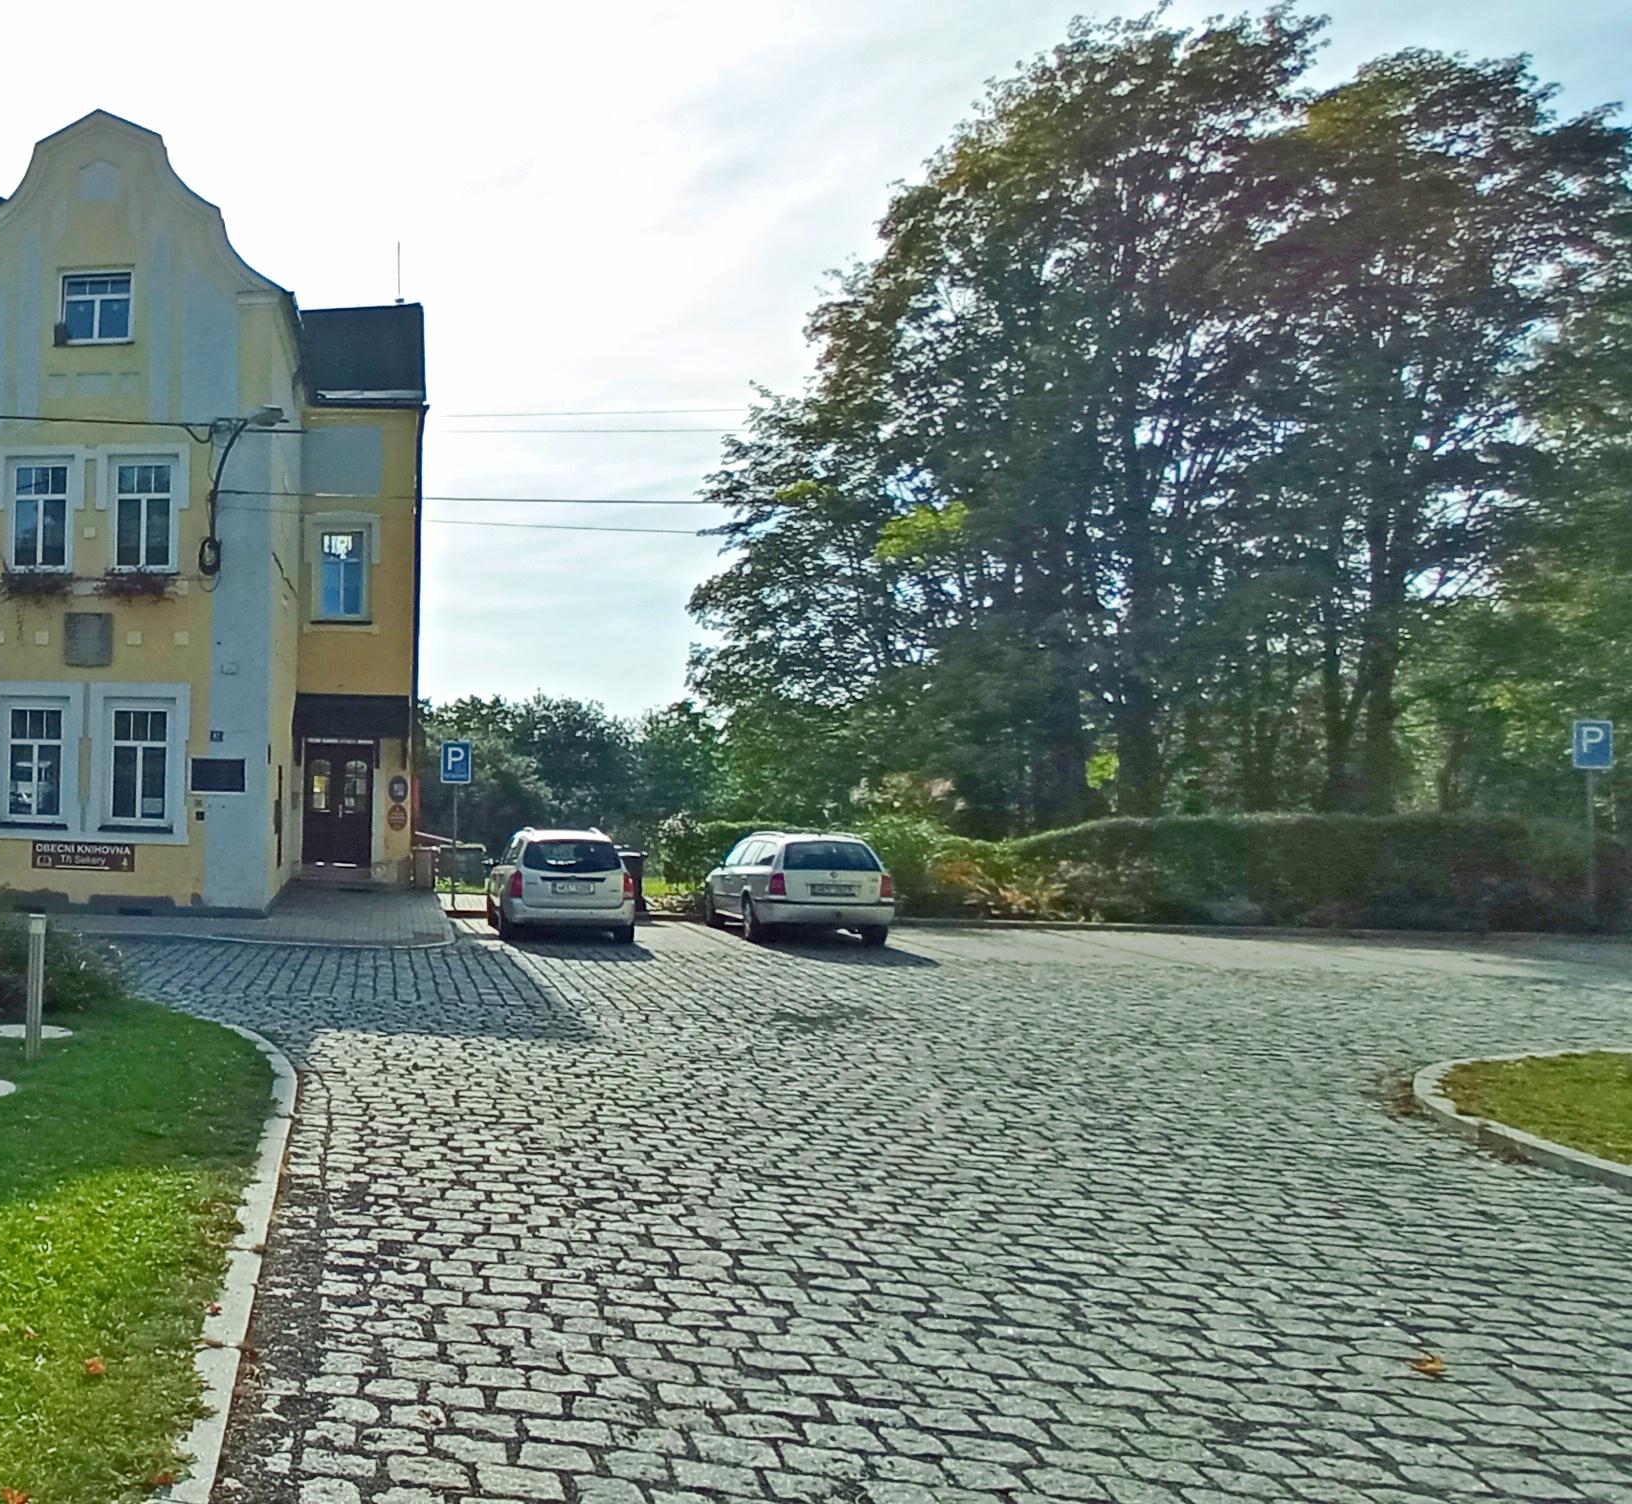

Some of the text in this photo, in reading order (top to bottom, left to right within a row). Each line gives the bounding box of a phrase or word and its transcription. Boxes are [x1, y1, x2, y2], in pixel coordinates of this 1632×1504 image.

[1582, 726, 1604, 753] P
[448, 747, 465, 770] P
[77, 845, 131, 855] KNIHOVNA
